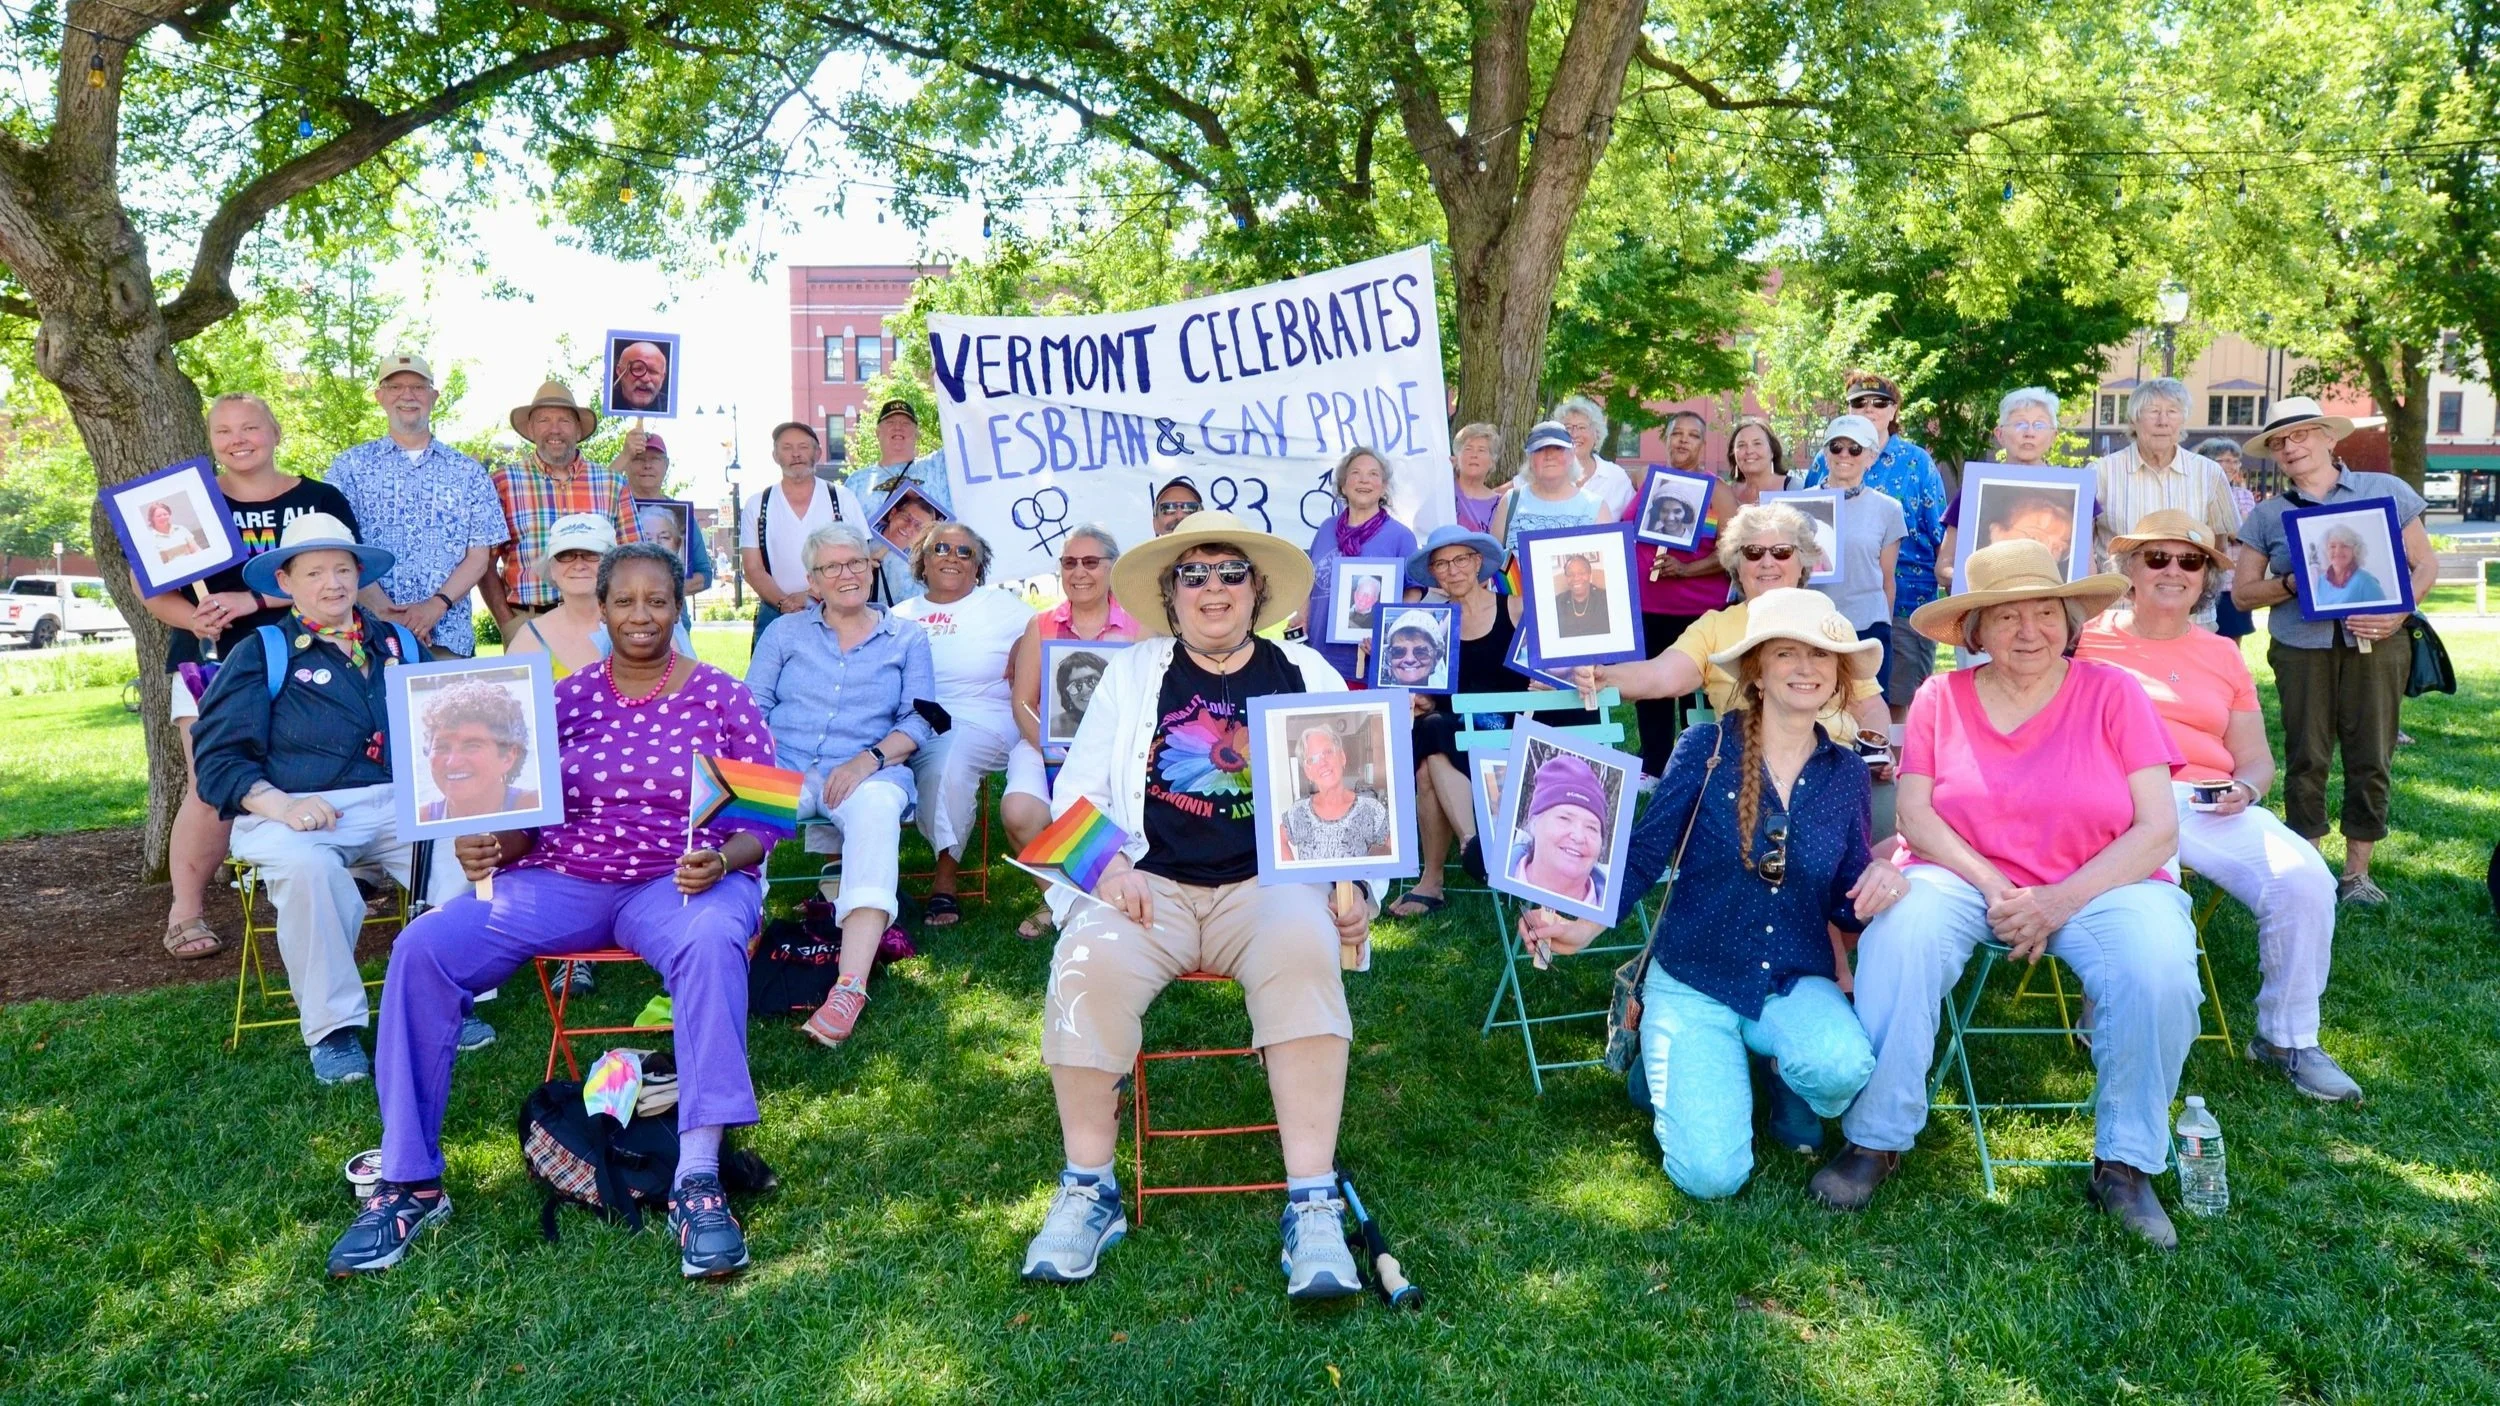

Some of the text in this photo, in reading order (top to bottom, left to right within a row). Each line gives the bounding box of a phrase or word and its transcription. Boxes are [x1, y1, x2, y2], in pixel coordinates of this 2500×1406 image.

[929, 273, 1422, 403] VERMONT CELEBRATES
[956, 380, 1428, 485] LESBIAN & GAY PRIDE
[232, 509, 277, 529] ARE
